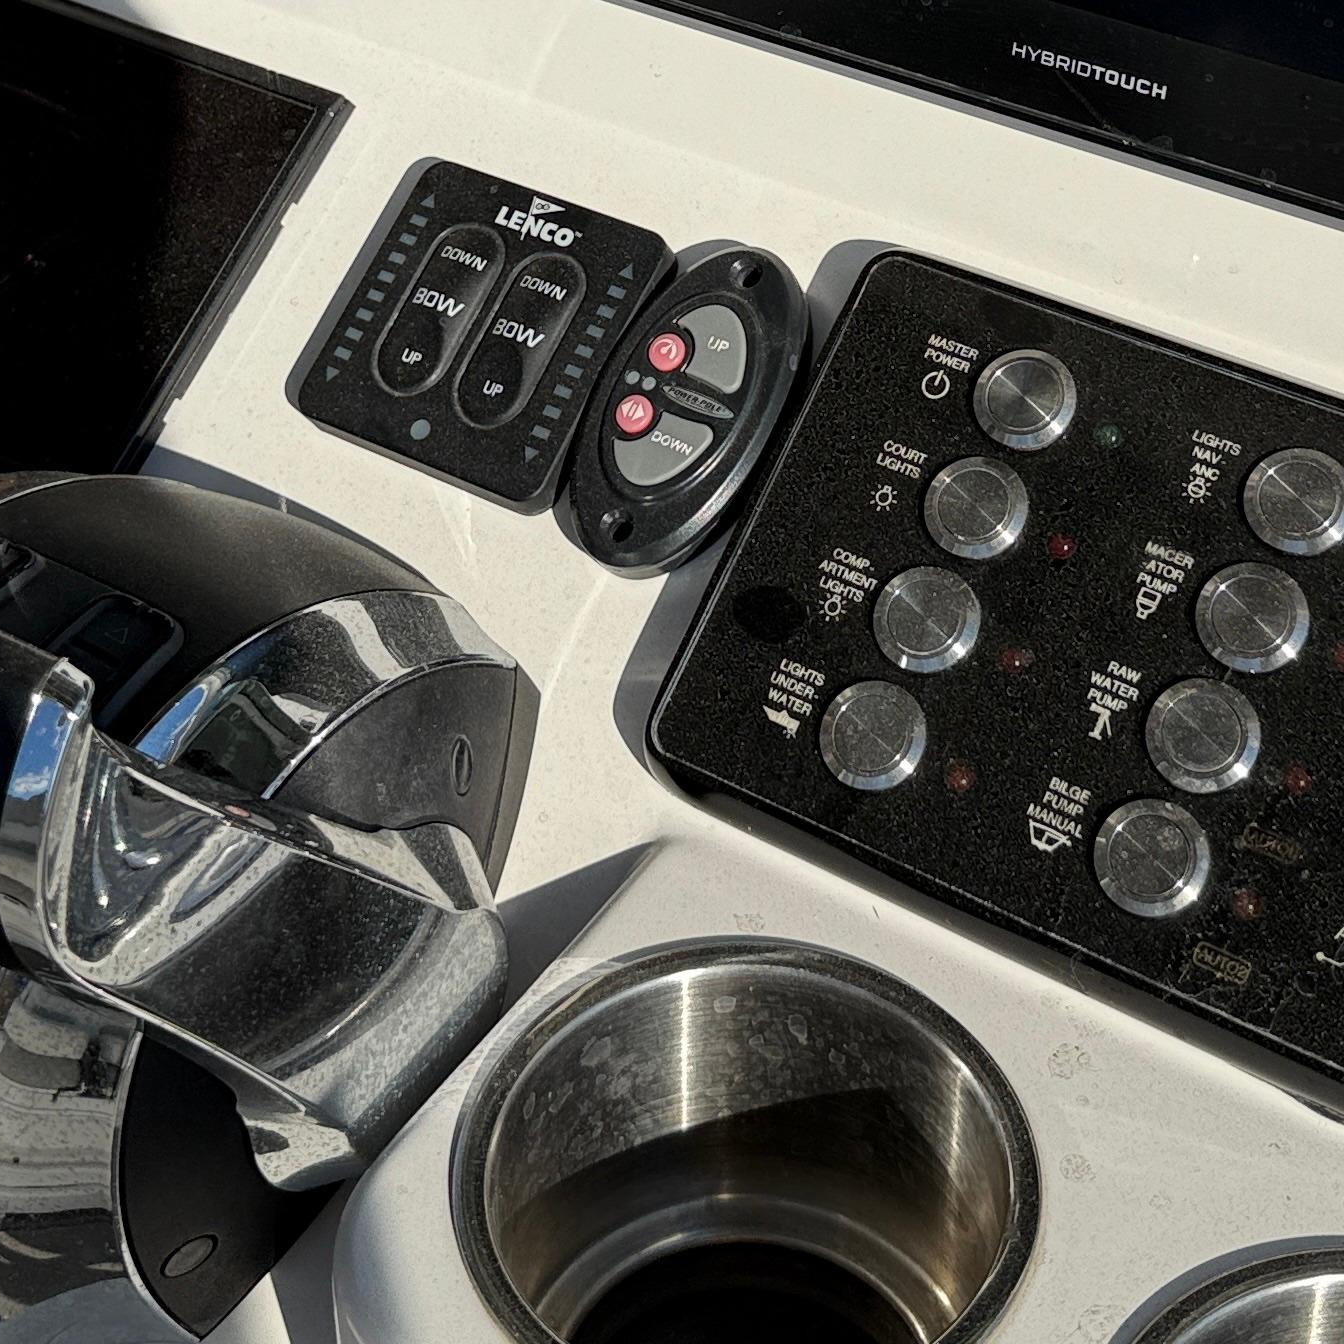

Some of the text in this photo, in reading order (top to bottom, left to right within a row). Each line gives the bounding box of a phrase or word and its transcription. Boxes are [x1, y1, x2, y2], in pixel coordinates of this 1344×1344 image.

[1011, 42, 1167, 100] HYBRIDTOUCH
[494, 205, 575, 248] LENCO
[440, 246, 488, 272] DOWN
[520, 275, 567, 301] DOWN
[412, 287, 466, 317] BOW
[492, 318, 546, 348] BOW
[707, 335, 730, 353] UP
[401, 347, 423, 365] UP
[924, 347, 971, 374] POWER
[927, 333, 980, 361] MASTER
[482, 379, 504, 397] UP
[650, 430, 694, 456] DOWN
[883, 440, 928, 465] COURT
[1191, 429, 1242, 456] LIGHTS
[876, 452, 921, 479] LIGHTS
[1189, 462, 1220, 481] ANC
[1144, 540, 1195, 570] MACER
[818, 559, 878, 592] ARTMENT
[819, 575, 865, 603] LIGHTS
[1136, 572, 1178, 595] PUMP
[779, 658, 826, 687] LIGHTS
[1107, 660, 1142, 684] RAW
[1087, 687, 1128, 712] PUMP
[1090, 670, 1140, 702] WATER
[768, 686, 813, 717] WATER
[1042, 790, 1085, 816] PUMP
[1049, 776, 1092, 806] BILGE
[1026, 802, 1083, 840] MANUAL
